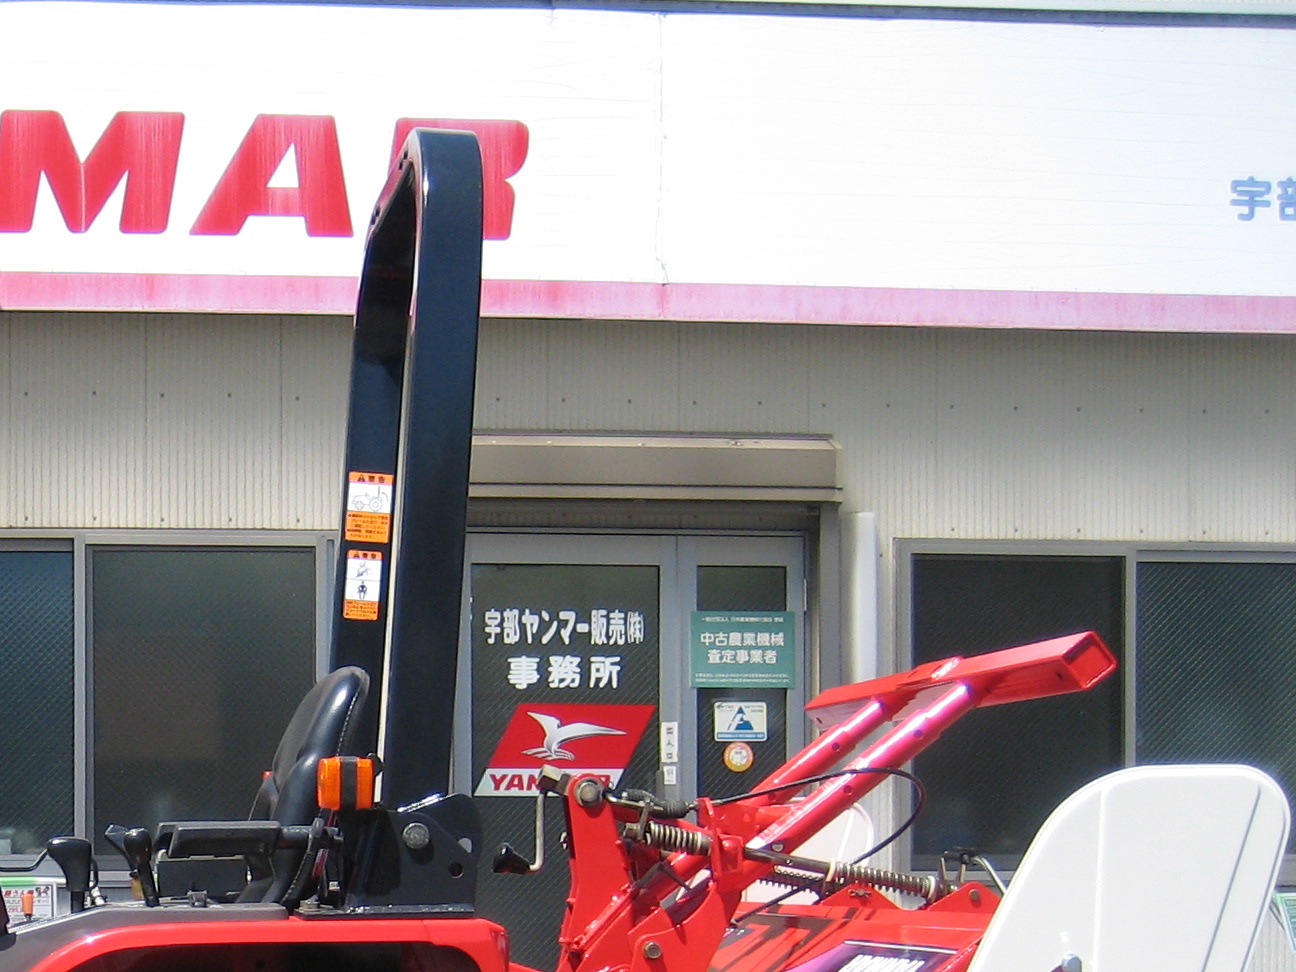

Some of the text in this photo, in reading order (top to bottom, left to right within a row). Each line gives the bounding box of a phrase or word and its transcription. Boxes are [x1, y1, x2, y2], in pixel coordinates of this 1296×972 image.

[707, 649, 777, 664] 査定事業者
[507, 655, 621, 690] 事務所
[489, 773, 611, 791] YAN
